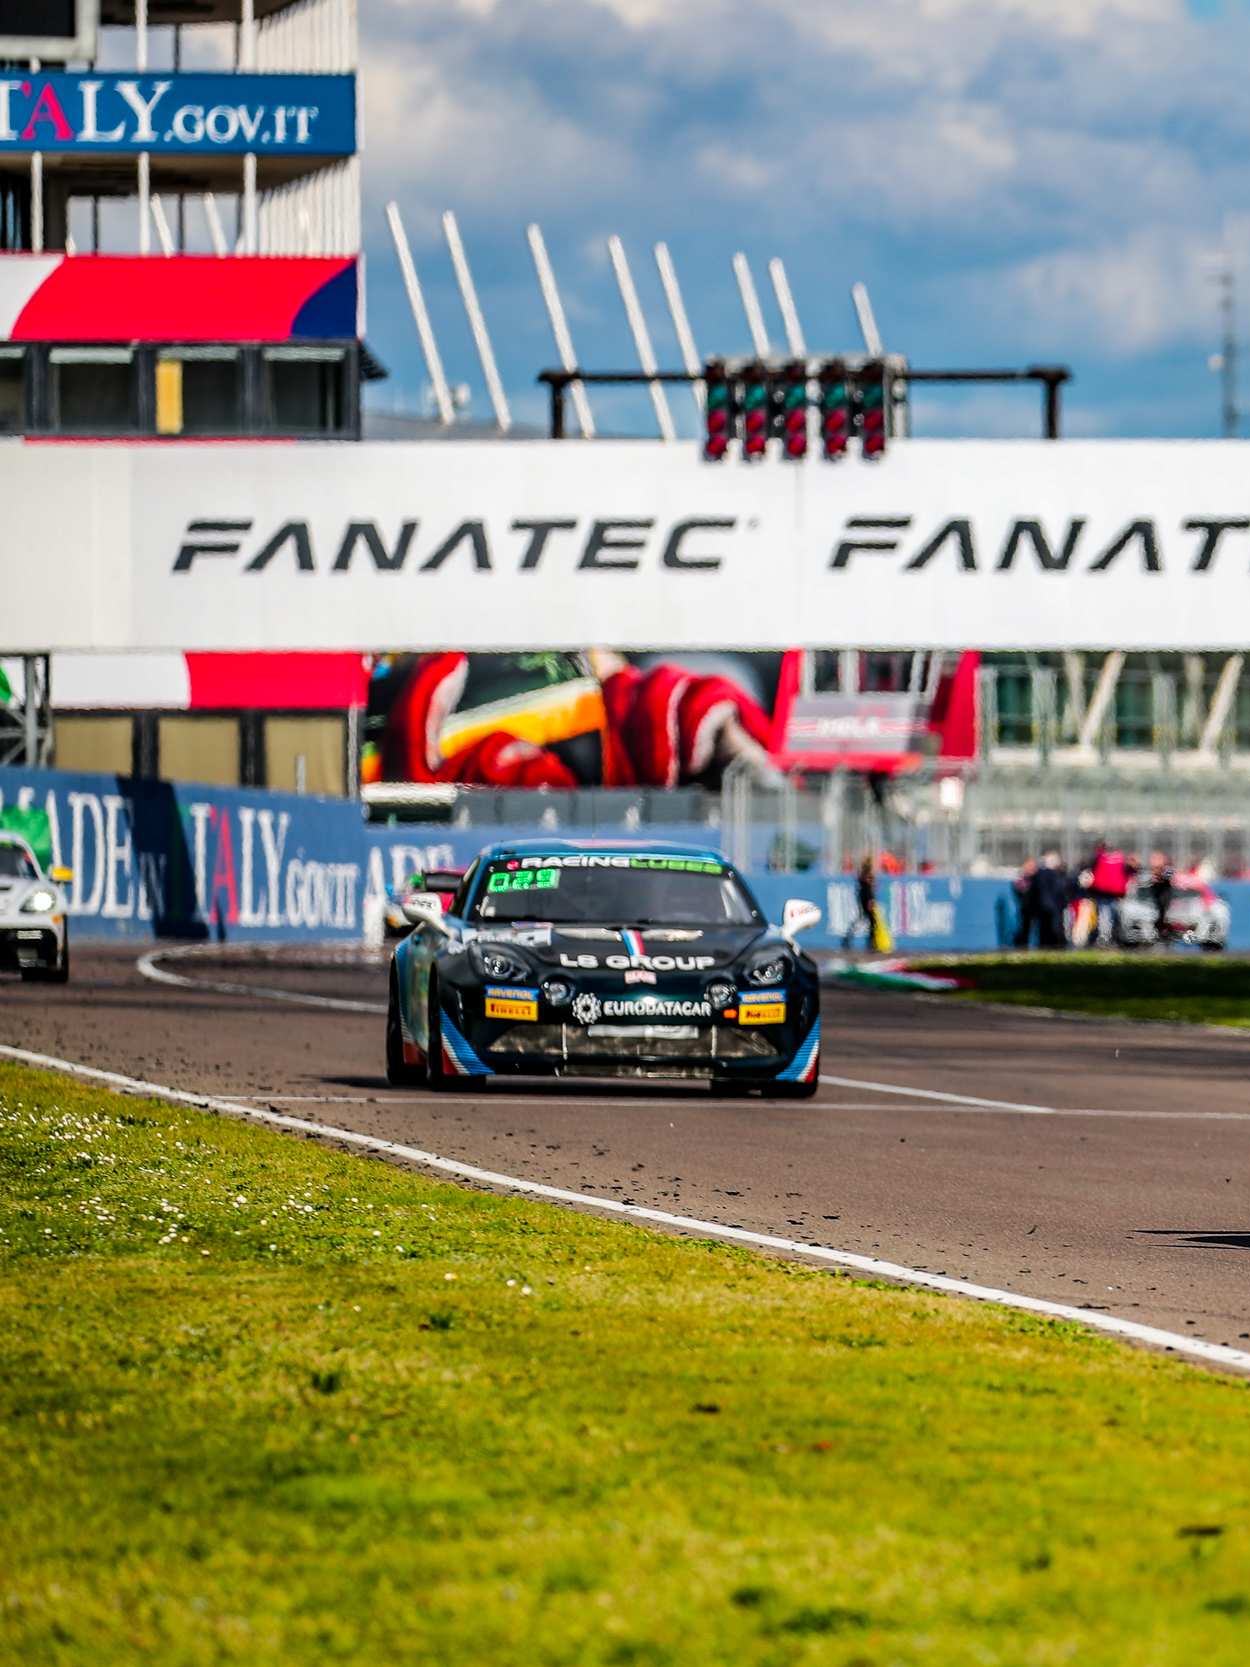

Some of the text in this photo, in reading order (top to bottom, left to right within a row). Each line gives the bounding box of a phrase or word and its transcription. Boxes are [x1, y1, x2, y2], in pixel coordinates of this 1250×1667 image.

[172, 516, 738, 573] FANATEC
[488, 868, 559, 893] 029
[559, 953, 716, 971] LS GROUP
